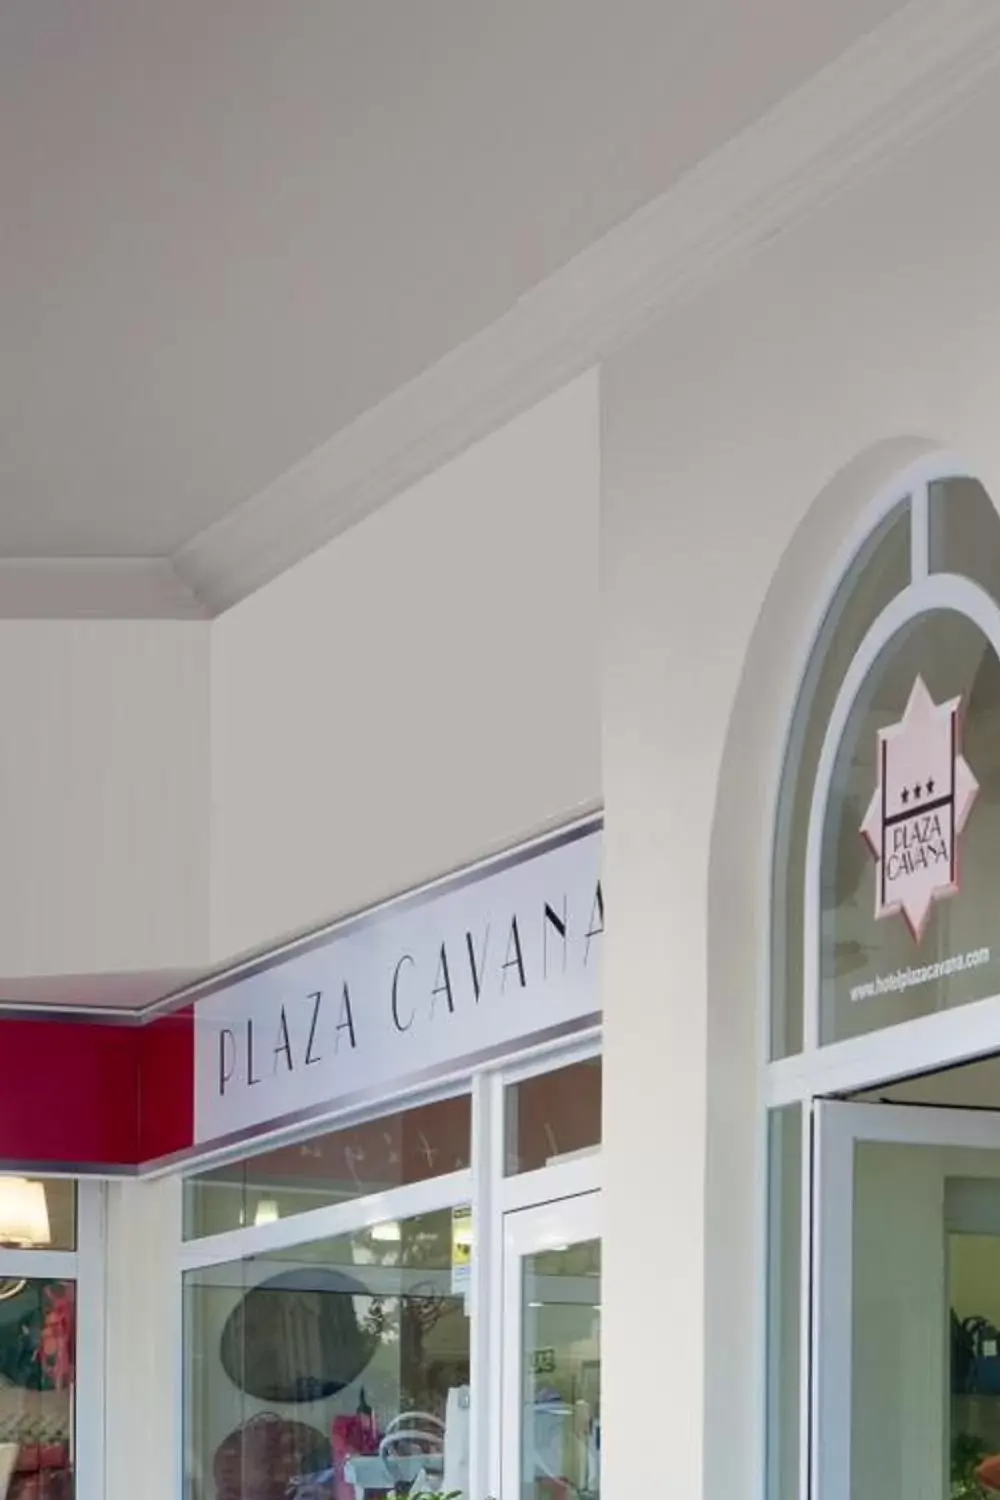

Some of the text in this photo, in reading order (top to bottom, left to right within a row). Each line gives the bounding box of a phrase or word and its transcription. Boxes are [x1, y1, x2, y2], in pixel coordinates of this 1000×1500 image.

[892, 813, 943, 852] PLAZA
[887, 841, 948, 881] CAVANA
[219, 879, 604, 1097] PLAZA CAVANA
[850, 946, 990, 1001] www.hotelplazacavana.com
